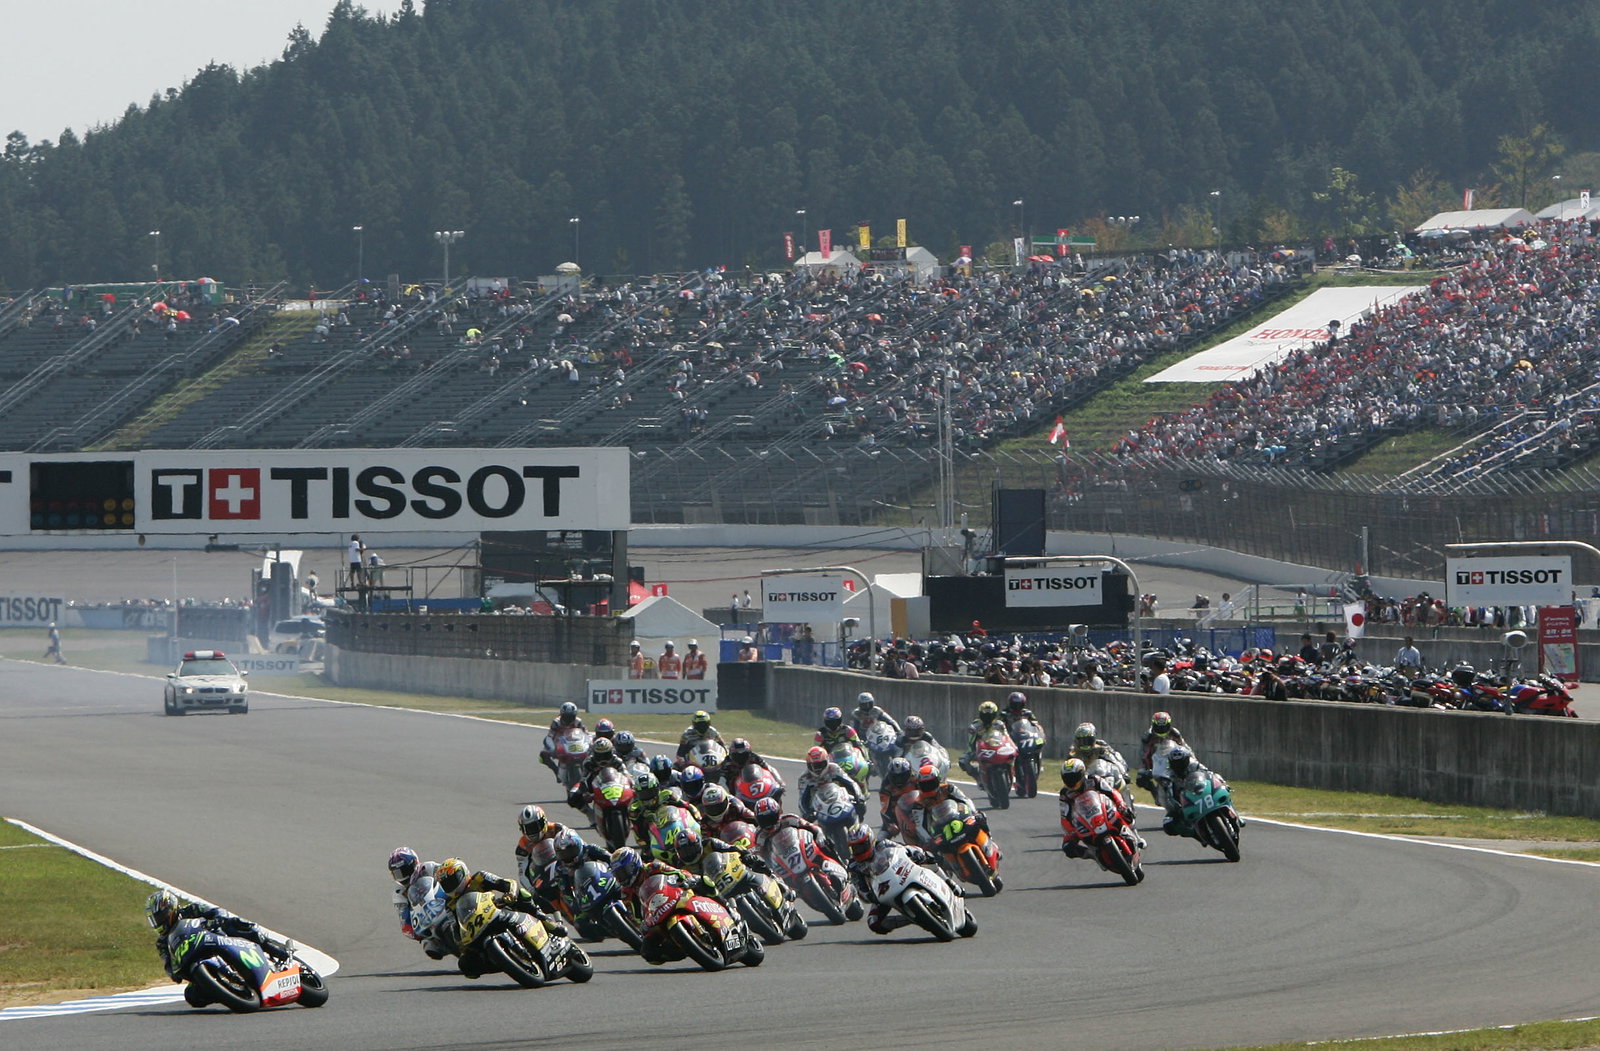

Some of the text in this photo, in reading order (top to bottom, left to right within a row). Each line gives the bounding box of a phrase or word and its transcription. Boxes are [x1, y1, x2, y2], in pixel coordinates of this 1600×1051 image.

[270, 465, 580, 519] TISSOT
[1034, 577, 1098, 590] TISSOT
[1486, 570, 1562, 584] TISSOT
[788, 592, 837, 602] TISSOT
[0, 597, 62, 622] TISSOT
[241, 661, 295, 670] TISSOT
[625, 688, 710, 704] TISSOT
[702, 755, 718, 768] 36
[750, 782, 766, 797] 57
[1195, 794, 1215, 814] 78
[277, 974, 300, 988] REPSOL
